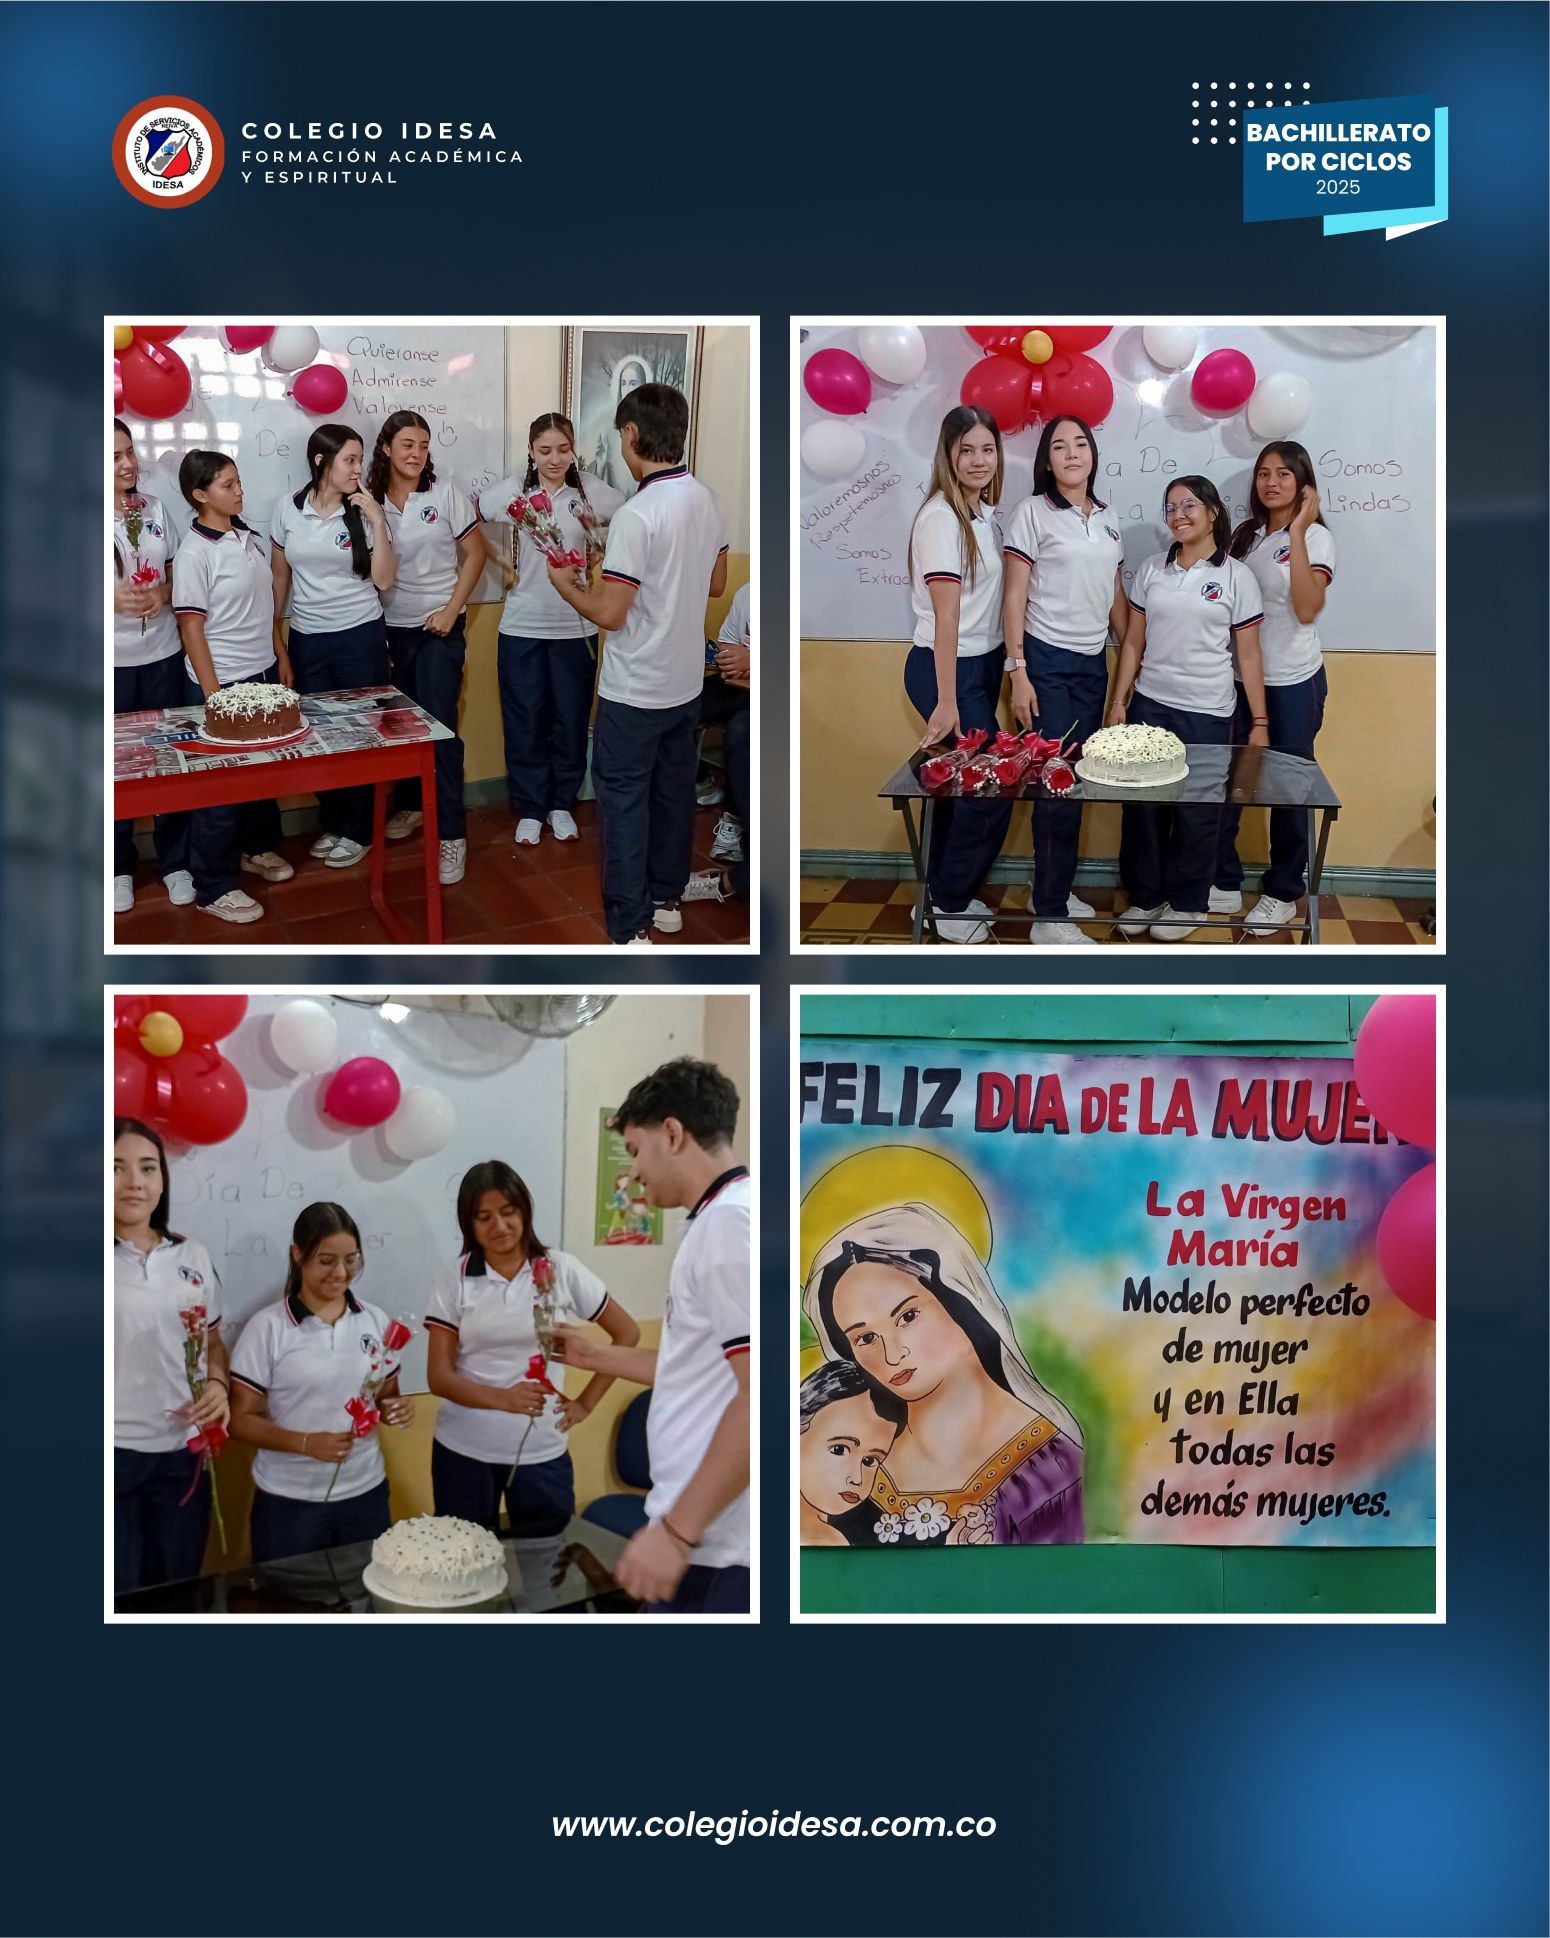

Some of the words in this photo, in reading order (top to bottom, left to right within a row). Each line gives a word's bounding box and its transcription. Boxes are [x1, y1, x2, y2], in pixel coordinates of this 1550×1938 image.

[352, 368, 438, 387] Admirense
[256, 428, 290, 457] De
[1140, 446, 1177, 474] De
[1319, 449, 1403, 478] Somos
[1326, 488, 1411, 513] Lindas
[836, 543, 892, 560] Somos
[975, 1071, 1070, 1135] DIA
[1081, 1084, 1130, 1133] DE
[1138, 1077, 1199, 1136] LA
[1212, 1079, 1411, 1146] MUJE
[1146, 1181, 1205, 1217] La
[1221, 1183, 1347, 1230] Virgen
[1167, 1229, 1299, 1268] María
[1122, 1276, 1231, 1314] Modelo
[1240, 1282, 1371, 1325] perfecto
[1162, 1327, 1204, 1364] de
[1213, 1338, 1308, 1374] mujer
[1154, 1387, 1171, 1423] y
[1185, 1389, 1224, 1416] en
[1238, 1380, 1299, 1416] Ella
[1169, 1428, 1275, 1467] todas
[1284, 1431, 1336, 1466] las
[1140, 1479, 1248, 1517] demás
[1256, 1491, 1391, 1526] mujeres.
